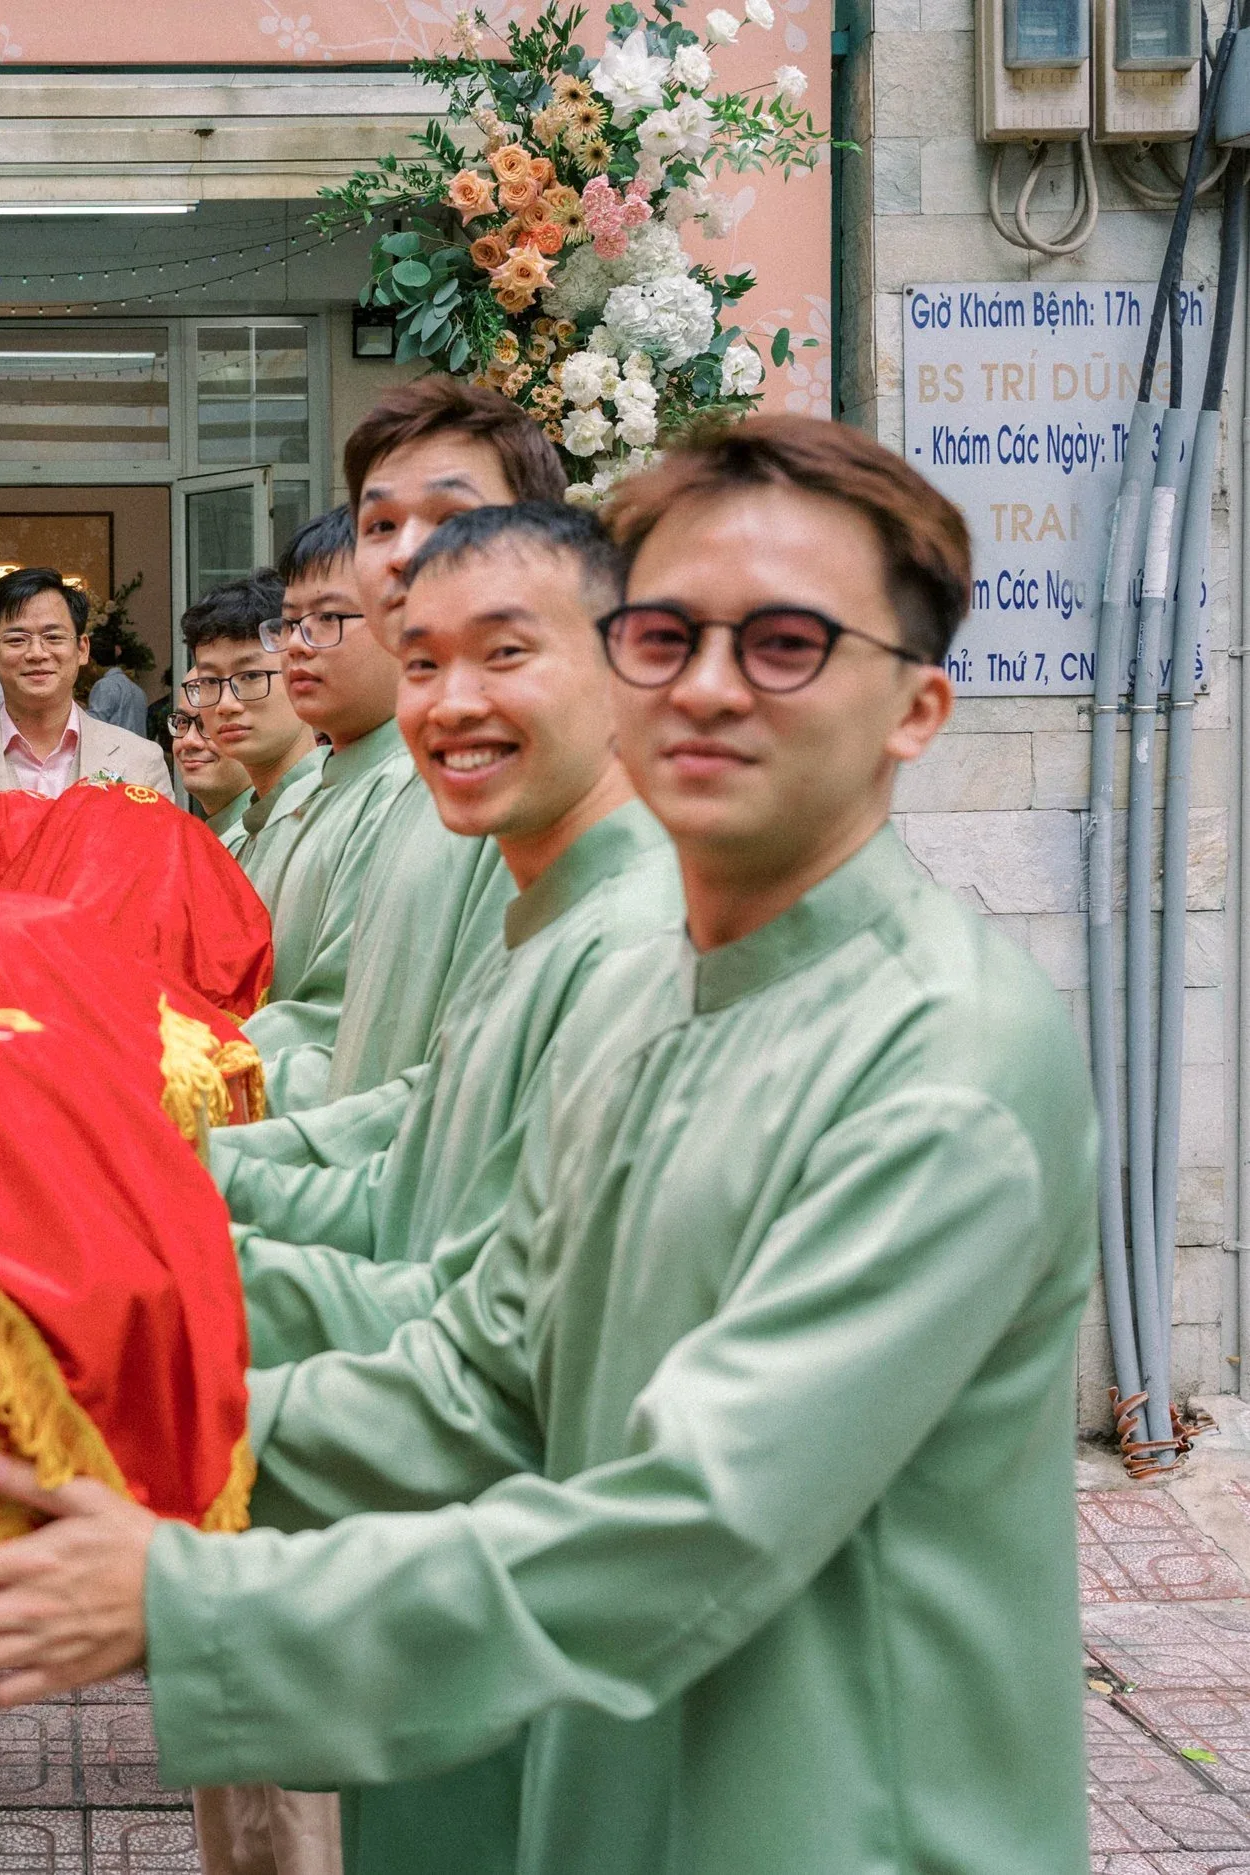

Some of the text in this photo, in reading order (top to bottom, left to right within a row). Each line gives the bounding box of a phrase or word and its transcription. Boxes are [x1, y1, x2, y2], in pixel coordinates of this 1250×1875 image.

[912, 292, 951, 329] Giờ
[960, 291, 1025, 328] Khám
[1033, 291, 1094, 335] Bệnh:
[1104, 291, 1140, 327] 17h
[918, 349, 1171, 403] BS TRÍ DŨNG
[932, 425, 990, 465] Khám
[997, 424, 1039, 465] Các
[1047, 422, 1105, 475] Ngày:
[997, 569, 1039, 610] Các
[987, 651, 1027, 682] Thứ
